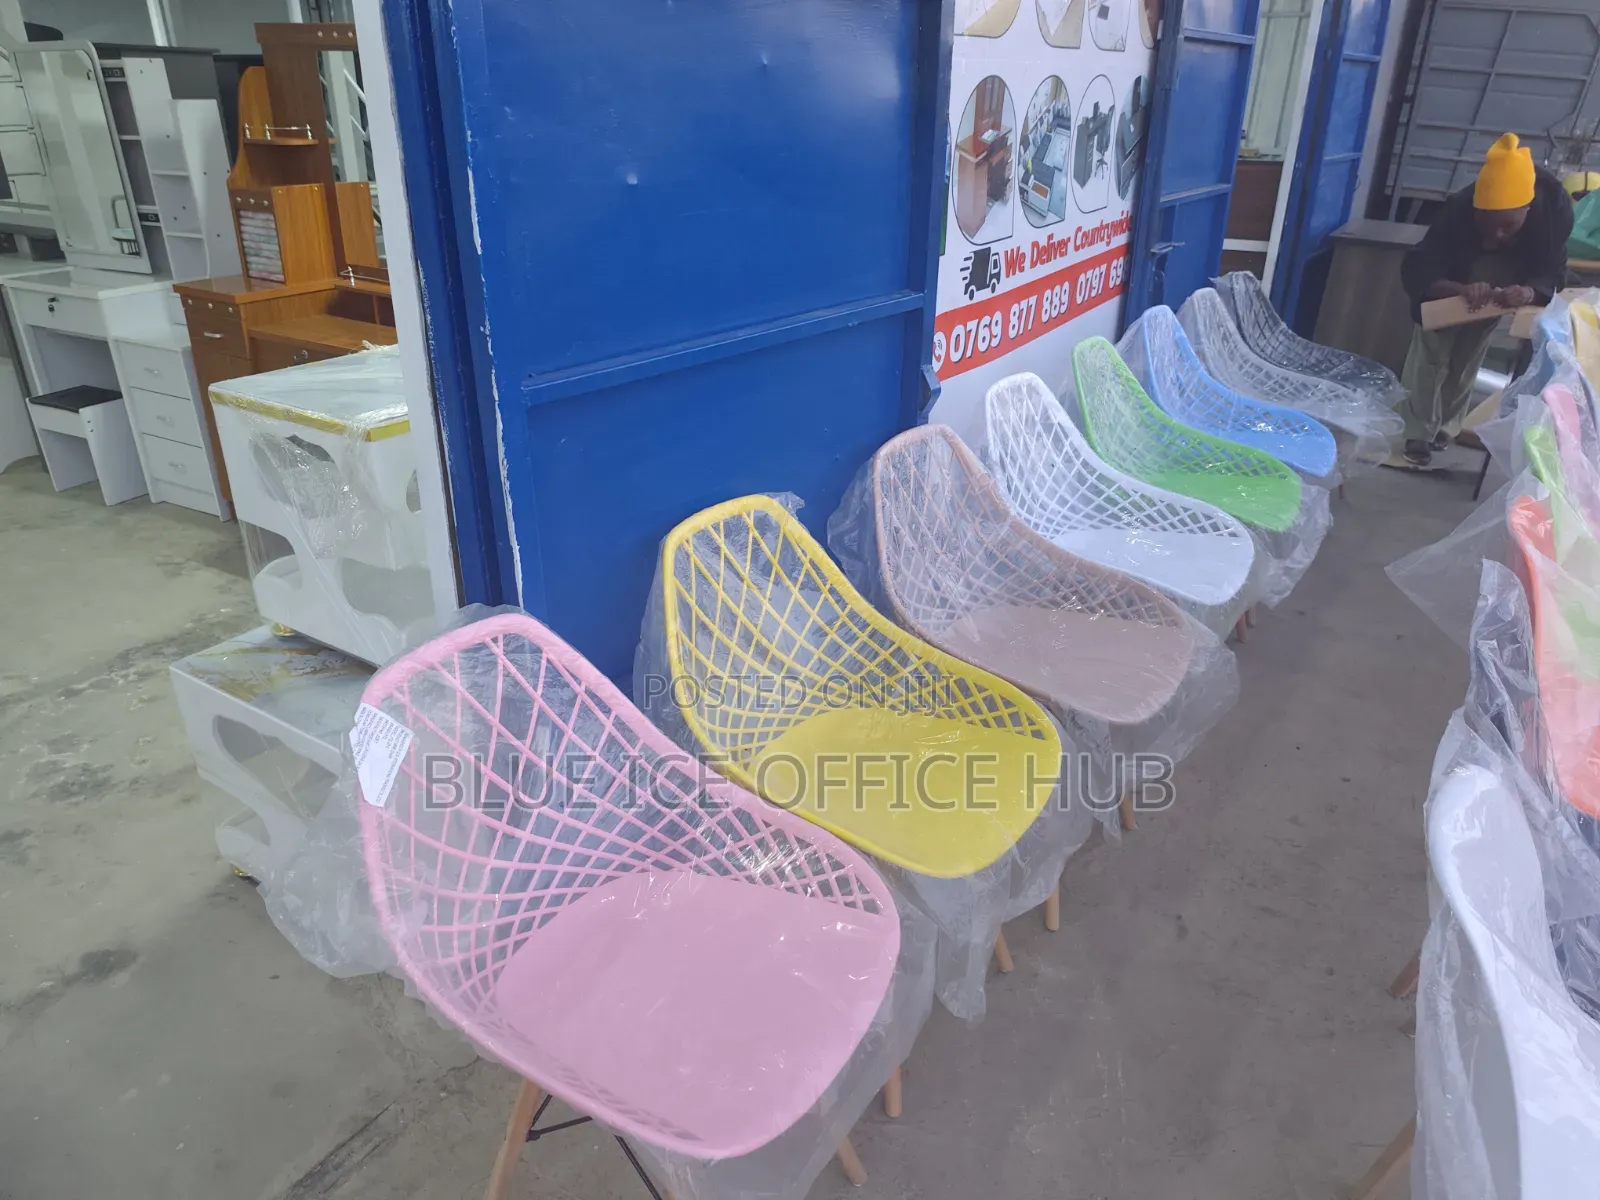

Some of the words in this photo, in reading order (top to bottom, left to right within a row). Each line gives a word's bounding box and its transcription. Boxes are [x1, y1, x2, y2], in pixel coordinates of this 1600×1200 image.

[1004, 248, 1026, 278] We
[1030, 233, 1071, 270] Deliver
[949, 311, 1003, 363] 0769
[1008, 295, 1037, 340] 877
[1041, 281, 1070, 323] 889
[1075, 262, 1106, 305] 0797
